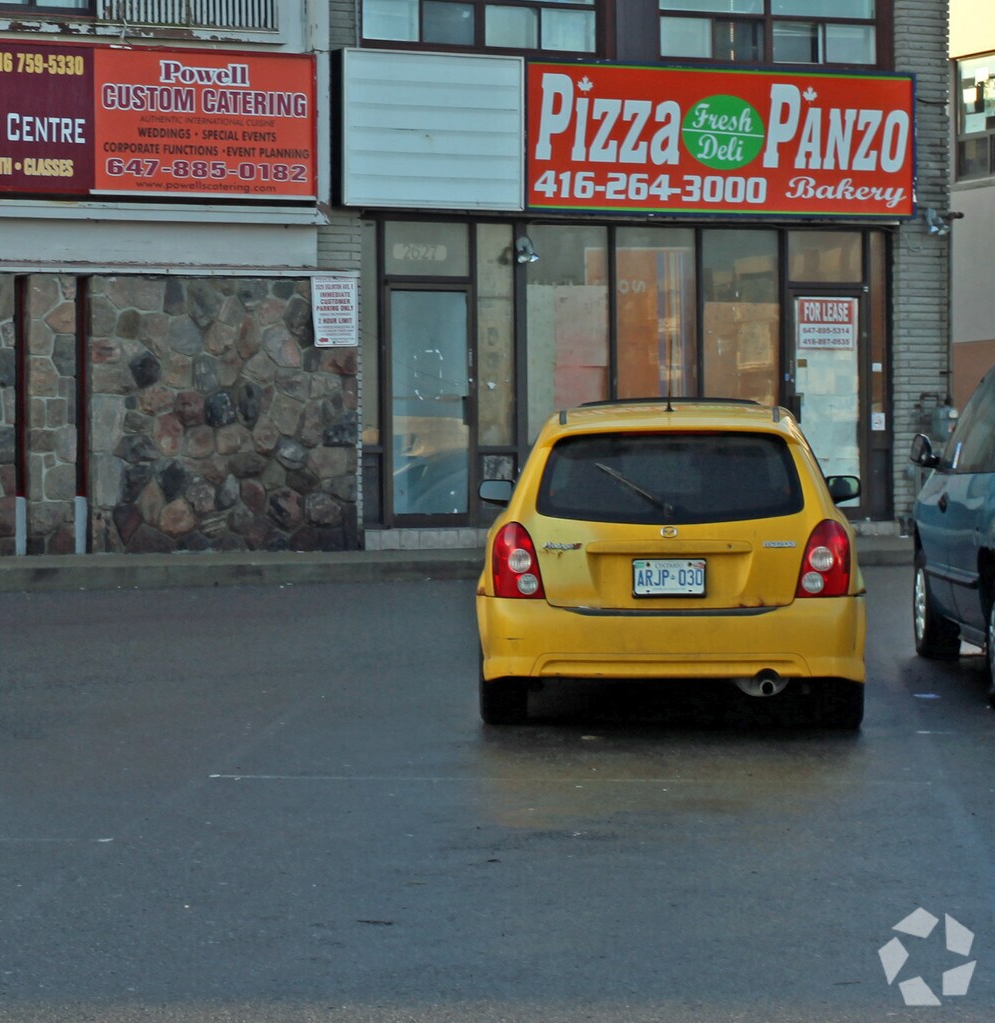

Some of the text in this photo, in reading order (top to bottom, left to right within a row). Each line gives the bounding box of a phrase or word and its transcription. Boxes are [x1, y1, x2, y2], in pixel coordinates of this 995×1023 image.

[17, 53, 84, 76] 759-5330
[159, 59, 250, 87] Powell
[102, 83, 308, 118] CUSTOM CATERING
[7, 112, 86, 144] CENTRE
[140, 115, 276, 127] AUTHENTIC INTERNATIONAL CUISINE
[535, 72, 910, 173] Pizza PANZO
[692, 103, 753, 133] Fresh
[138, 127, 277, 142] WEDDINGS SPECIAL EVENTS
[103, 142, 310, 159] CORPORATE FUNCTIONS EVENT PLANNING
[696, 134, 744, 162] Deli
[23, 157, 74, 177] CLASSES
[105, 157, 308, 183] 647-885-0182
[136, 180, 276, 193] www.powellscatering.com
[534, 170, 907, 208] 416-264-3000 Bakery
[804, 303, 848, 322] FOR LEASE
